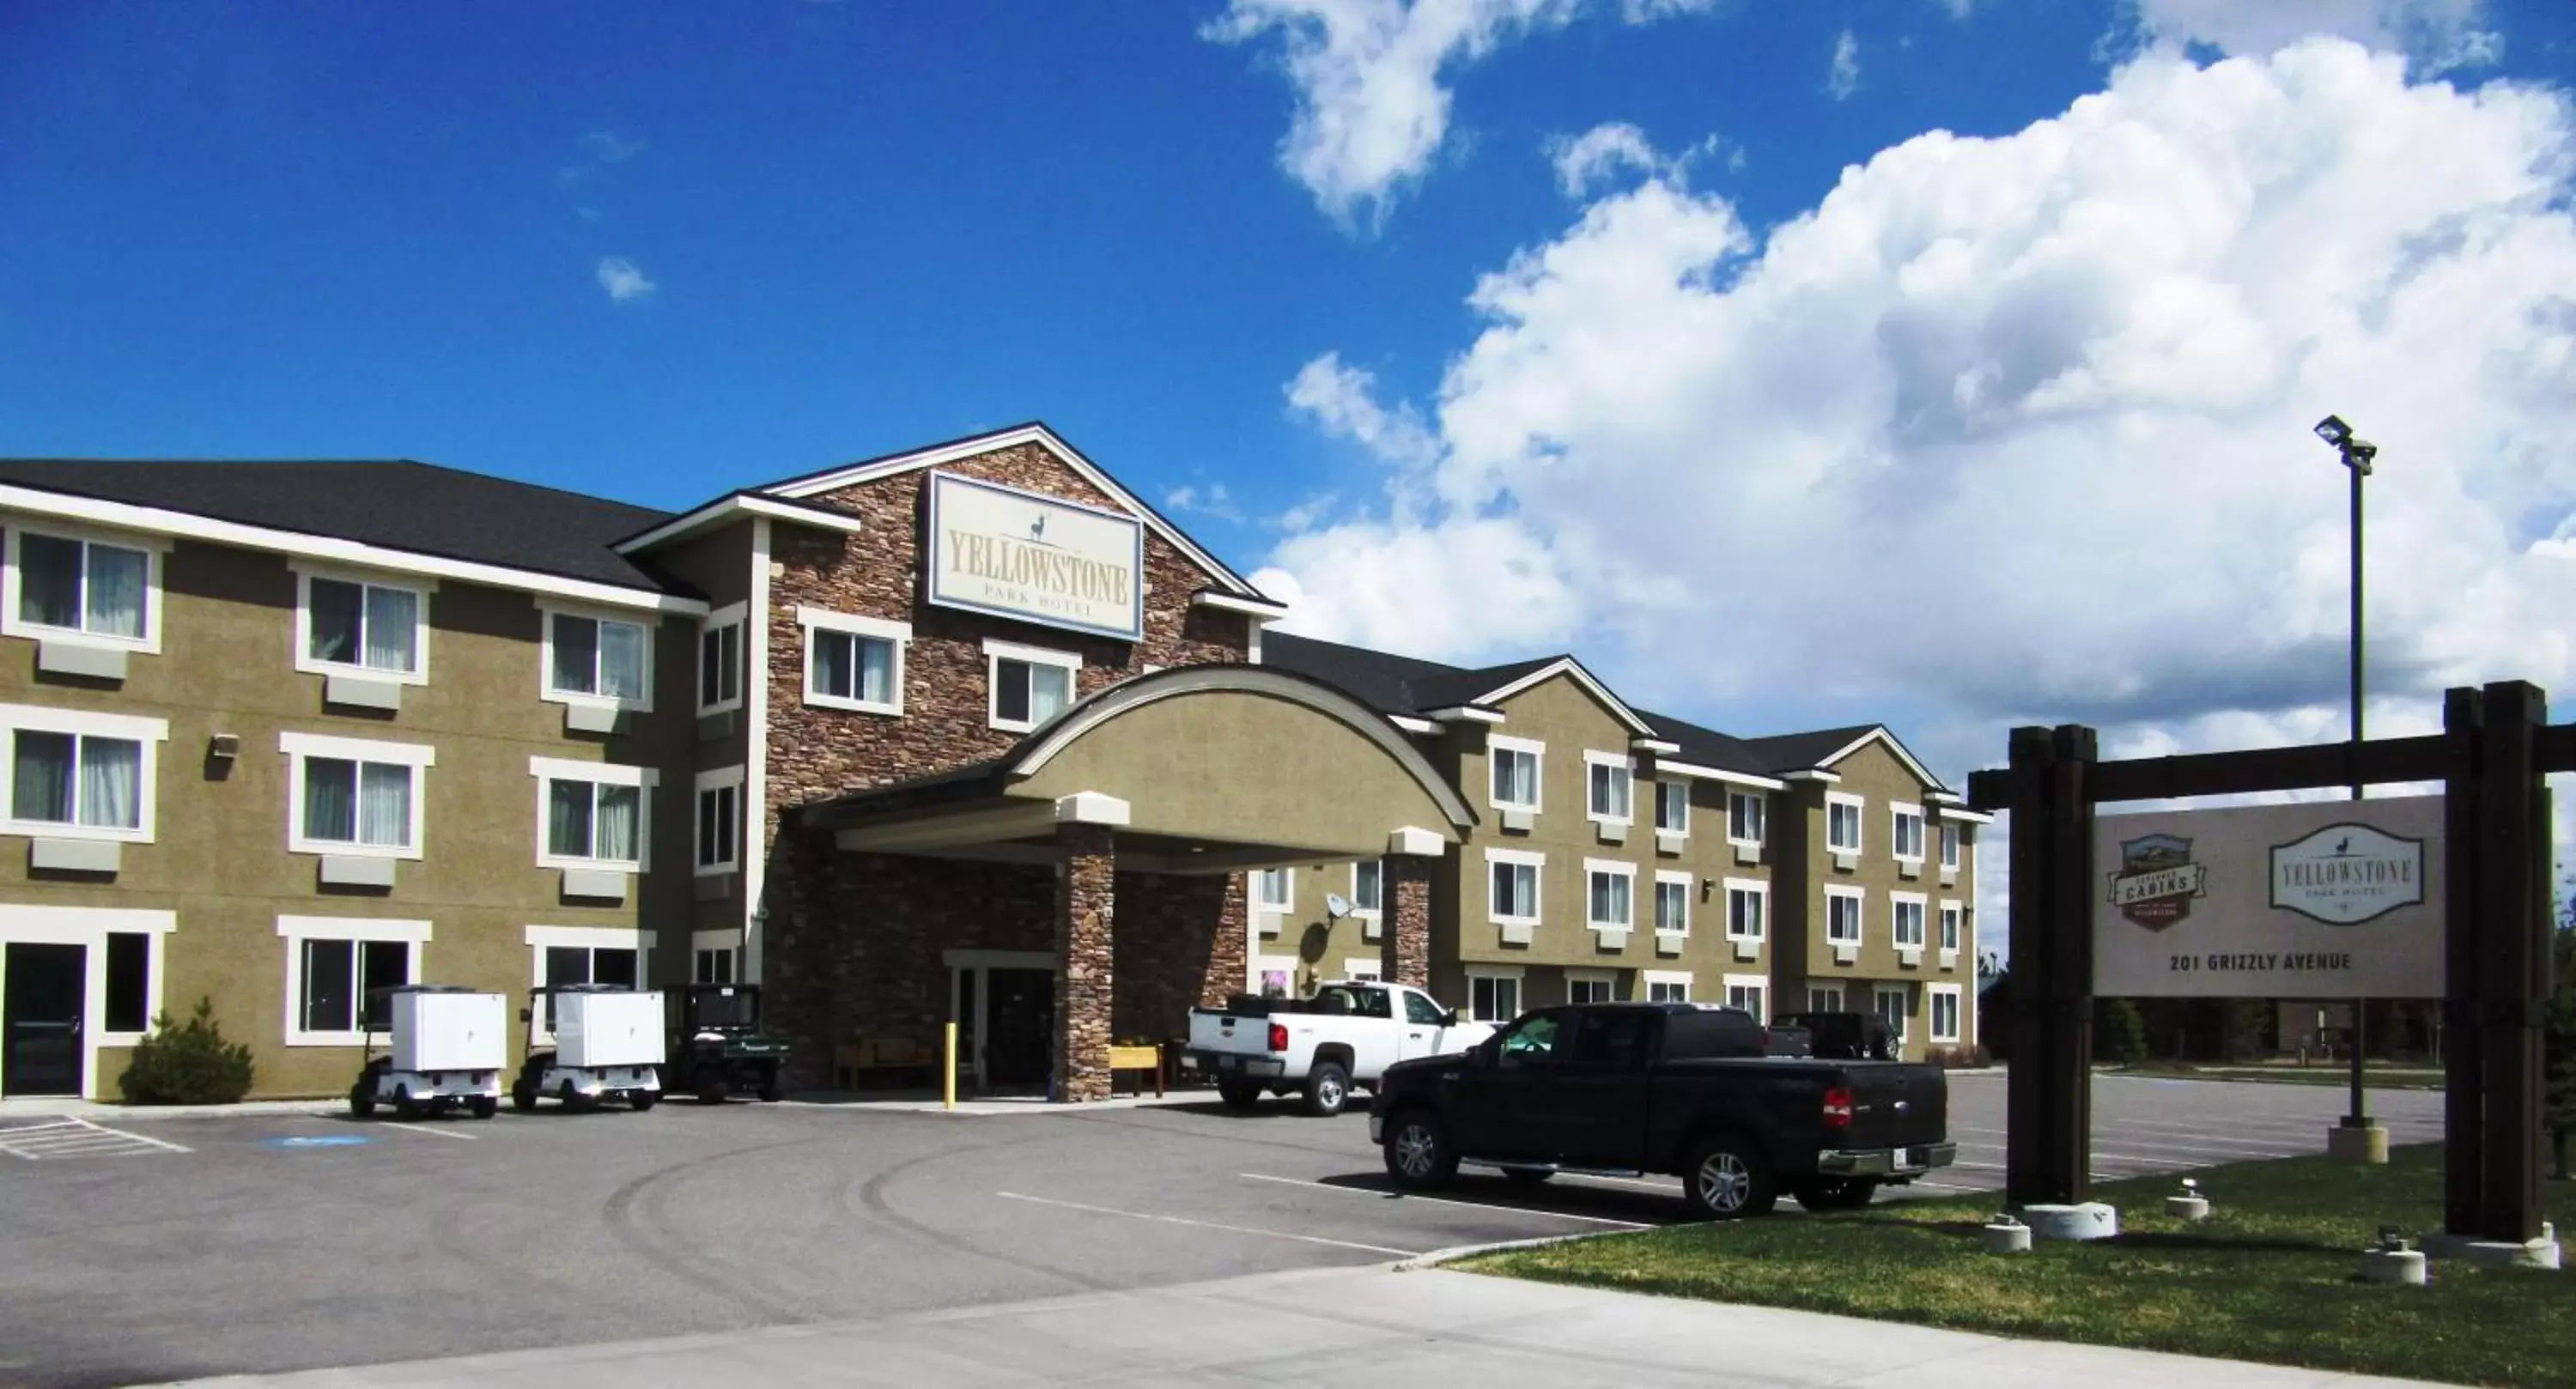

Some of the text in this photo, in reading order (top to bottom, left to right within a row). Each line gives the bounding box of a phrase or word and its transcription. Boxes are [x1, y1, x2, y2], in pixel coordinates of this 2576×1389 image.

[949, 530, 1127, 605] YELLOWSTONE
[985, 584, 1091, 616] PARK HOTEL
[2283, 858, 2412, 888] YELLOWSTONE
[2126, 876, 2187, 901] CABINS
[2170, 952, 2353, 972] 201 GRIZZLY AVENUE
